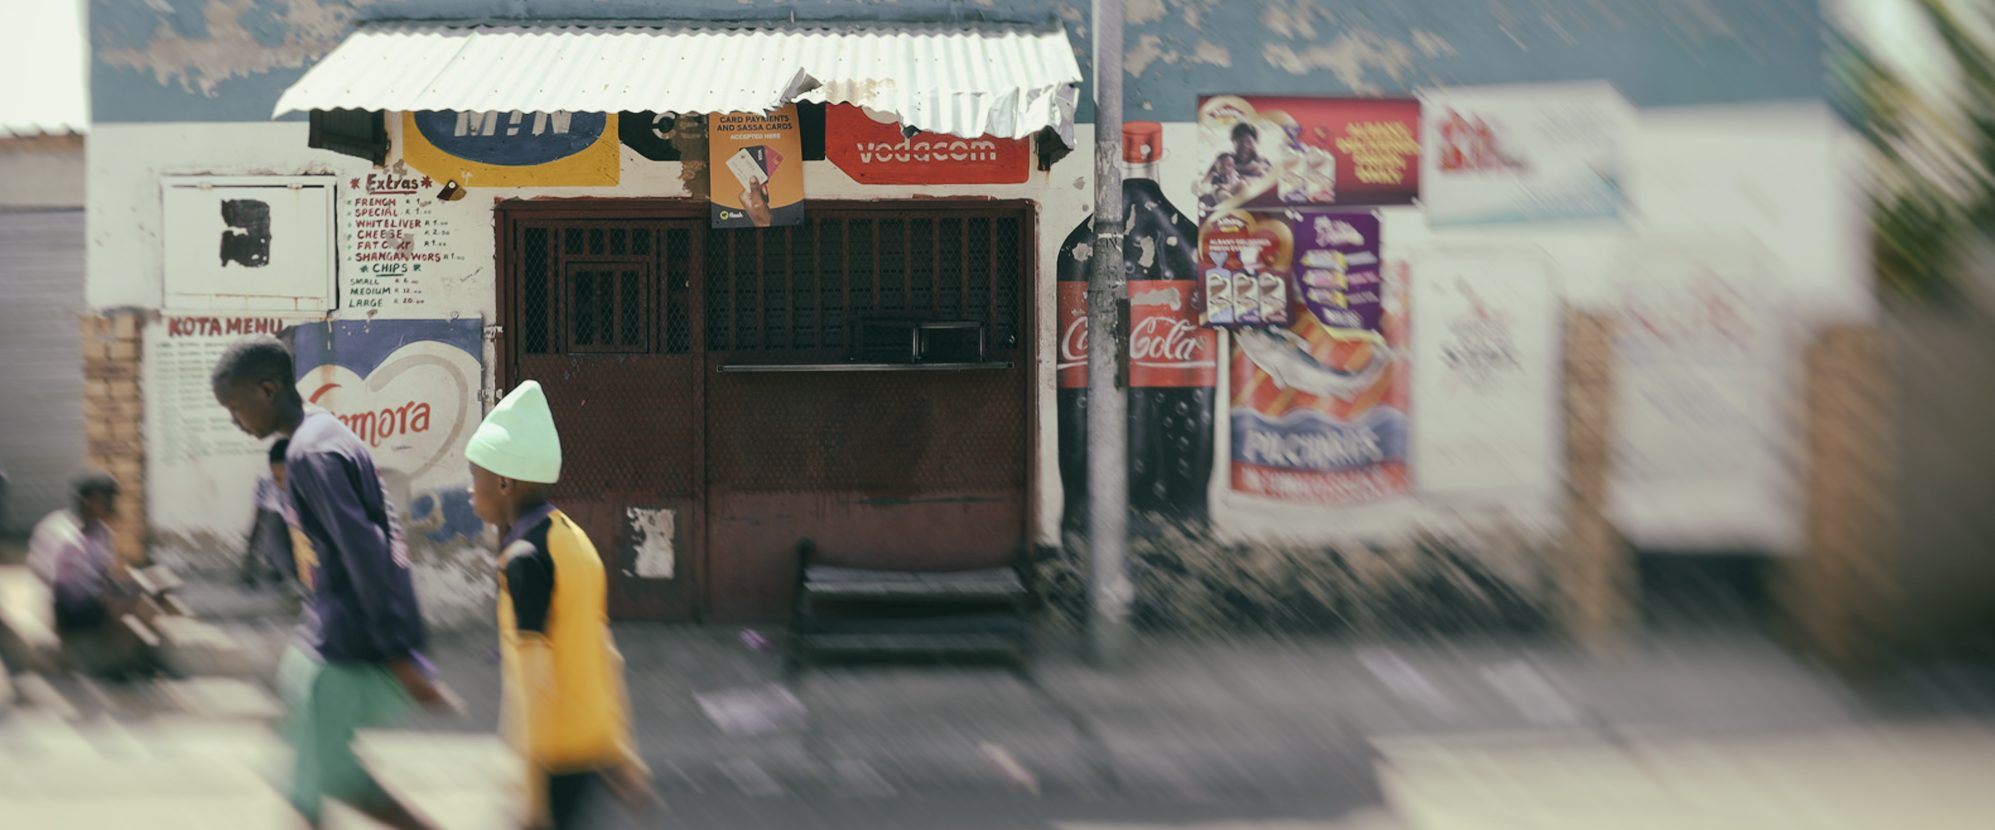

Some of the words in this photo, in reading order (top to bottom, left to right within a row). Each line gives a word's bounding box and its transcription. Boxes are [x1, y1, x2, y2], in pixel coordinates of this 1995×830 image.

[720, 115, 743, 123] CARD
[717, 124, 735, 132] AND
[737, 123, 763, 131] SASSA
[766, 122, 793, 130] CARDS
[857, 137, 997, 164] vodacom
[366, 173, 419, 192] Extras
[355, 198, 396, 207] FRENCH
[355, 208, 398, 217] SPECIAL
[357, 229, 403, 239] CHEESE
[411, 252, 441, 263] WORS
[372, 263, 408, 273] CHIPS
[350, 287, 391, 295] MEDIUM
[348, 298, 383, 308] LARGE
[168, 316, 222, 337] KOTA
[225, 317, 284, 335] MENU
